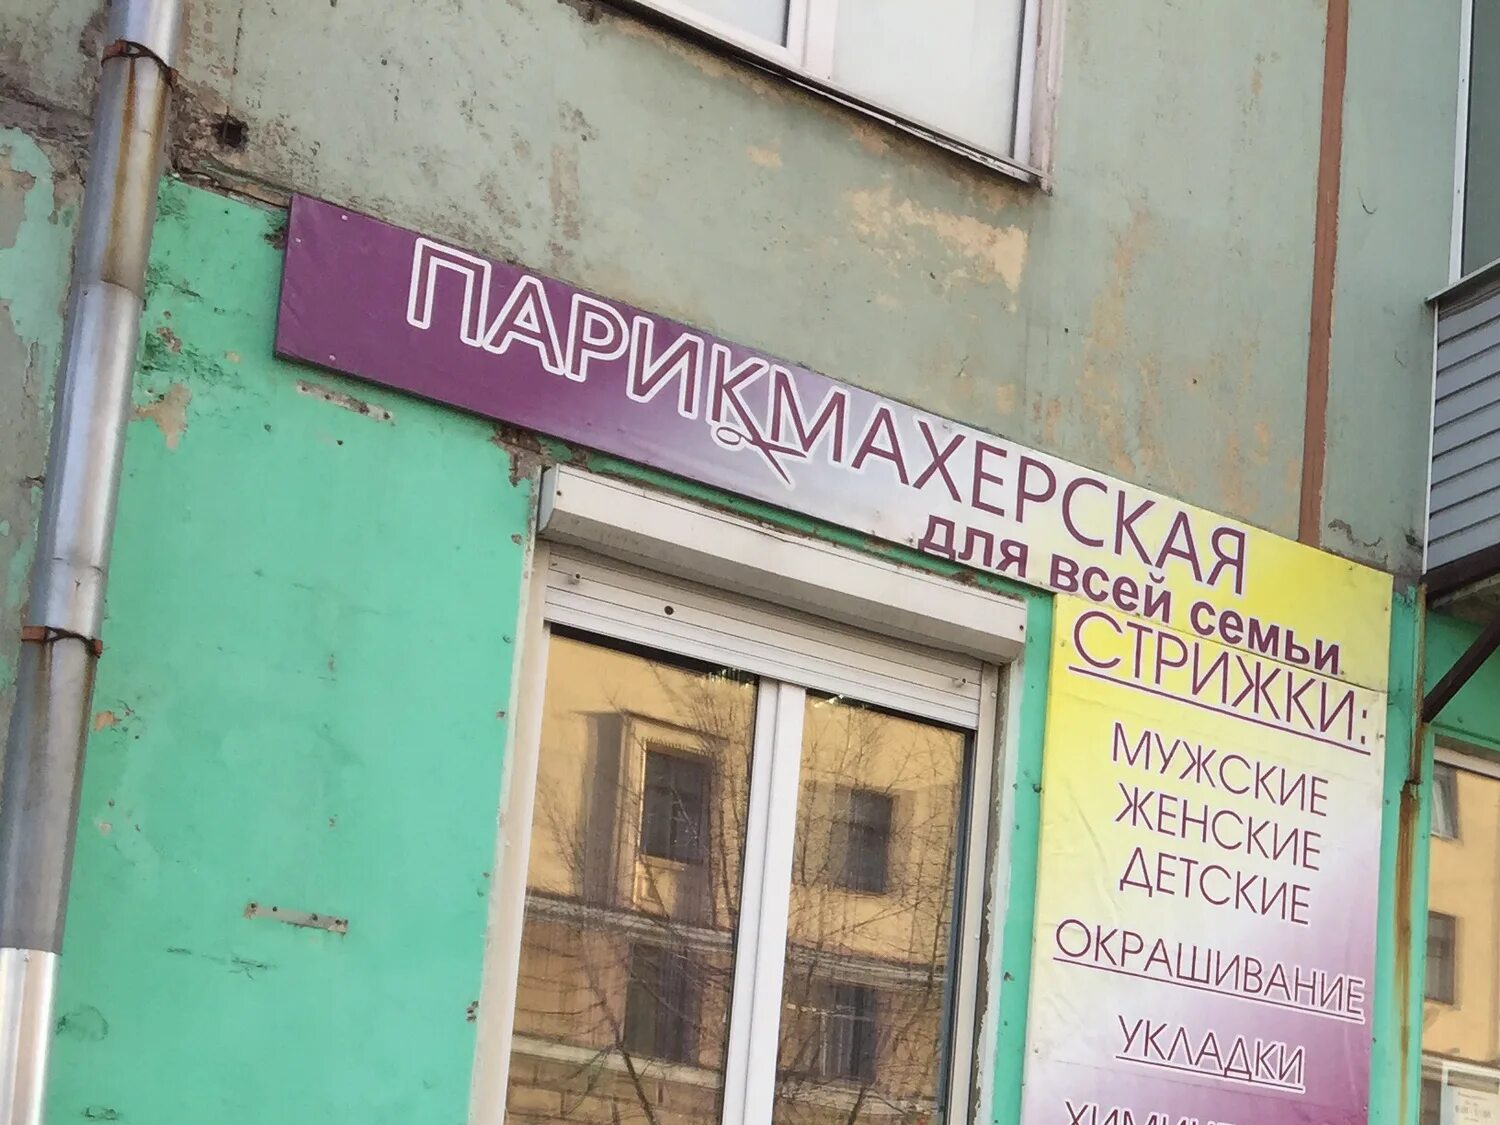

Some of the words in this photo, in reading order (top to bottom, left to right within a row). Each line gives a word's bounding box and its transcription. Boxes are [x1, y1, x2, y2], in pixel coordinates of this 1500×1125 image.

[406, 237, 1247, 595] ПАРИКМАХЕРСКАЯ
[917, 514, 1029, 578] для
[1048, 551, 1173, 625] всей
[1188, 600, 1340, 675] семьи
[1072, 610, 1368, 745] СТРИЖКИ:
[1112, 722, 1329, 817] МУЖСКИЕ
[1115, 782, 1322, 871] ЖЕНСКИЕ
[1119, 846, 1311, 925] ДЕТСКИЕ
[1055, 918, 1365, 1016] ОКРАШИВАНИЕ
[1117, 1014, 1305, 1085] УКЛАДКИ
